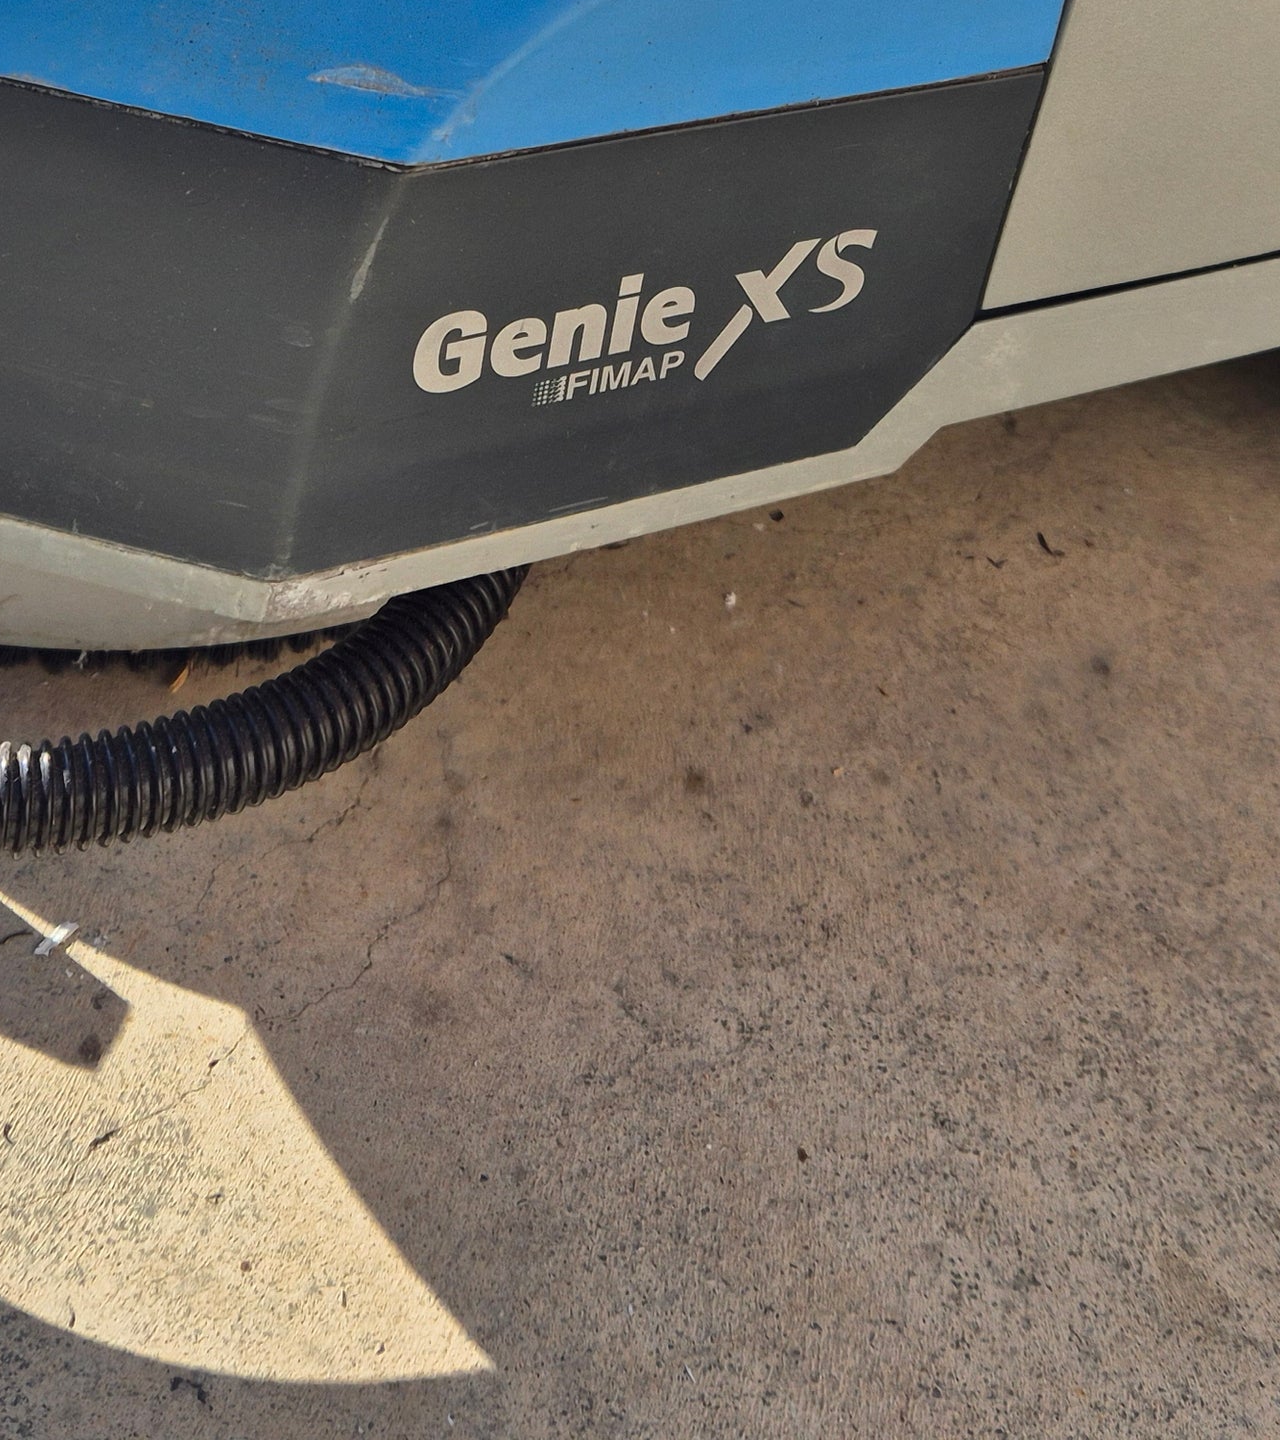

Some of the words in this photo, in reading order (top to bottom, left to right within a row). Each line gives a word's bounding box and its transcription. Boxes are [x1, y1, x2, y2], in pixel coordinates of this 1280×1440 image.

[412, 273, 696, 394] Genie
[694, 229, 879, 382] XS
[564, 350, 686, 401] FIMAP
